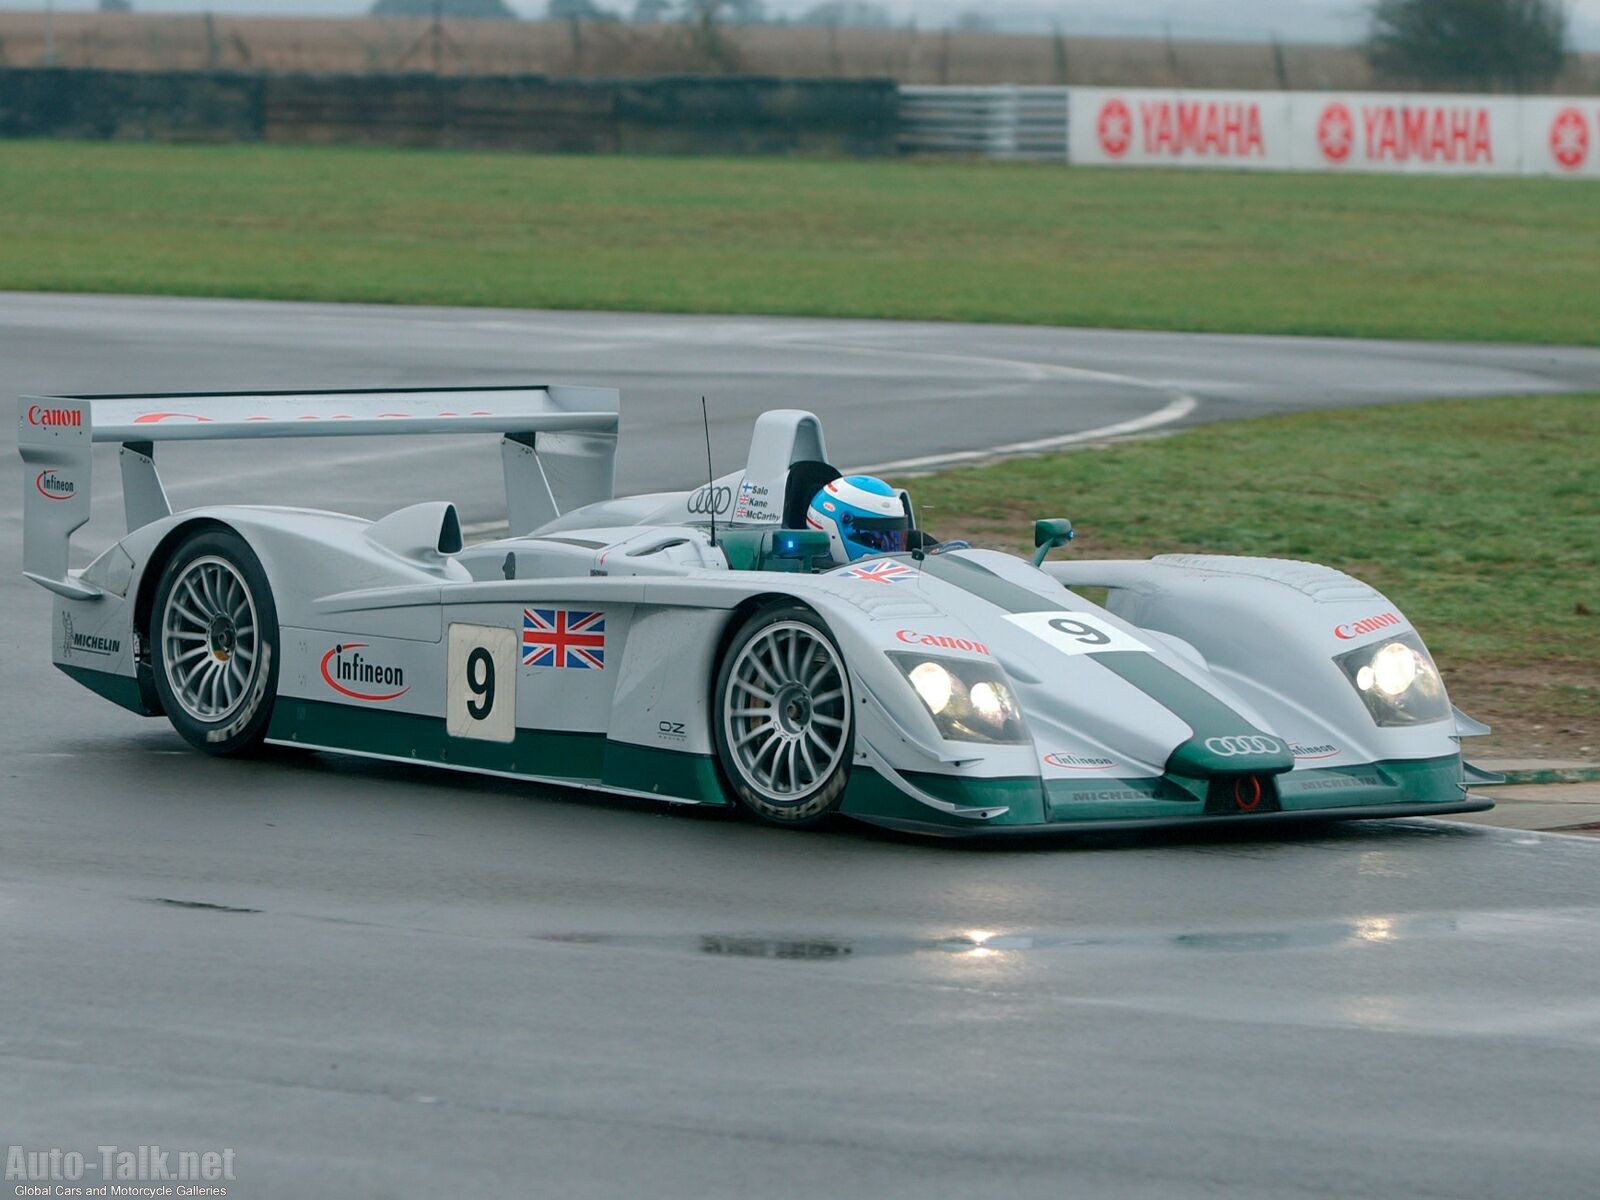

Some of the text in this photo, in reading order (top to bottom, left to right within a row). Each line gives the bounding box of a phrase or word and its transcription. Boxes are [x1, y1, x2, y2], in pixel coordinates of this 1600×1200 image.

[1139, 101, 1264, 158] YAMAHA
[1363, 105, 1493, 164] YAMAHA
[28, 405, 81, 427] Canon
[751, 485, 768, 496] Salo
[749, 498, 768, 508] Kane
[746, 510, 780, 522] McCarthy
[1047, 618, 1111, 645] 9
[1334, 612, 1401, 640] Canon
[73, 633, 121, 653] MICHELIN
[896, 630, 990, 656] Canon
[465, 646, 496, 720] 9
[659, 721, 686, 734] OZ
[1301, 777, 1377, 790] MICHELIN
[1072, 790, 1165, 801] MICHELIN
